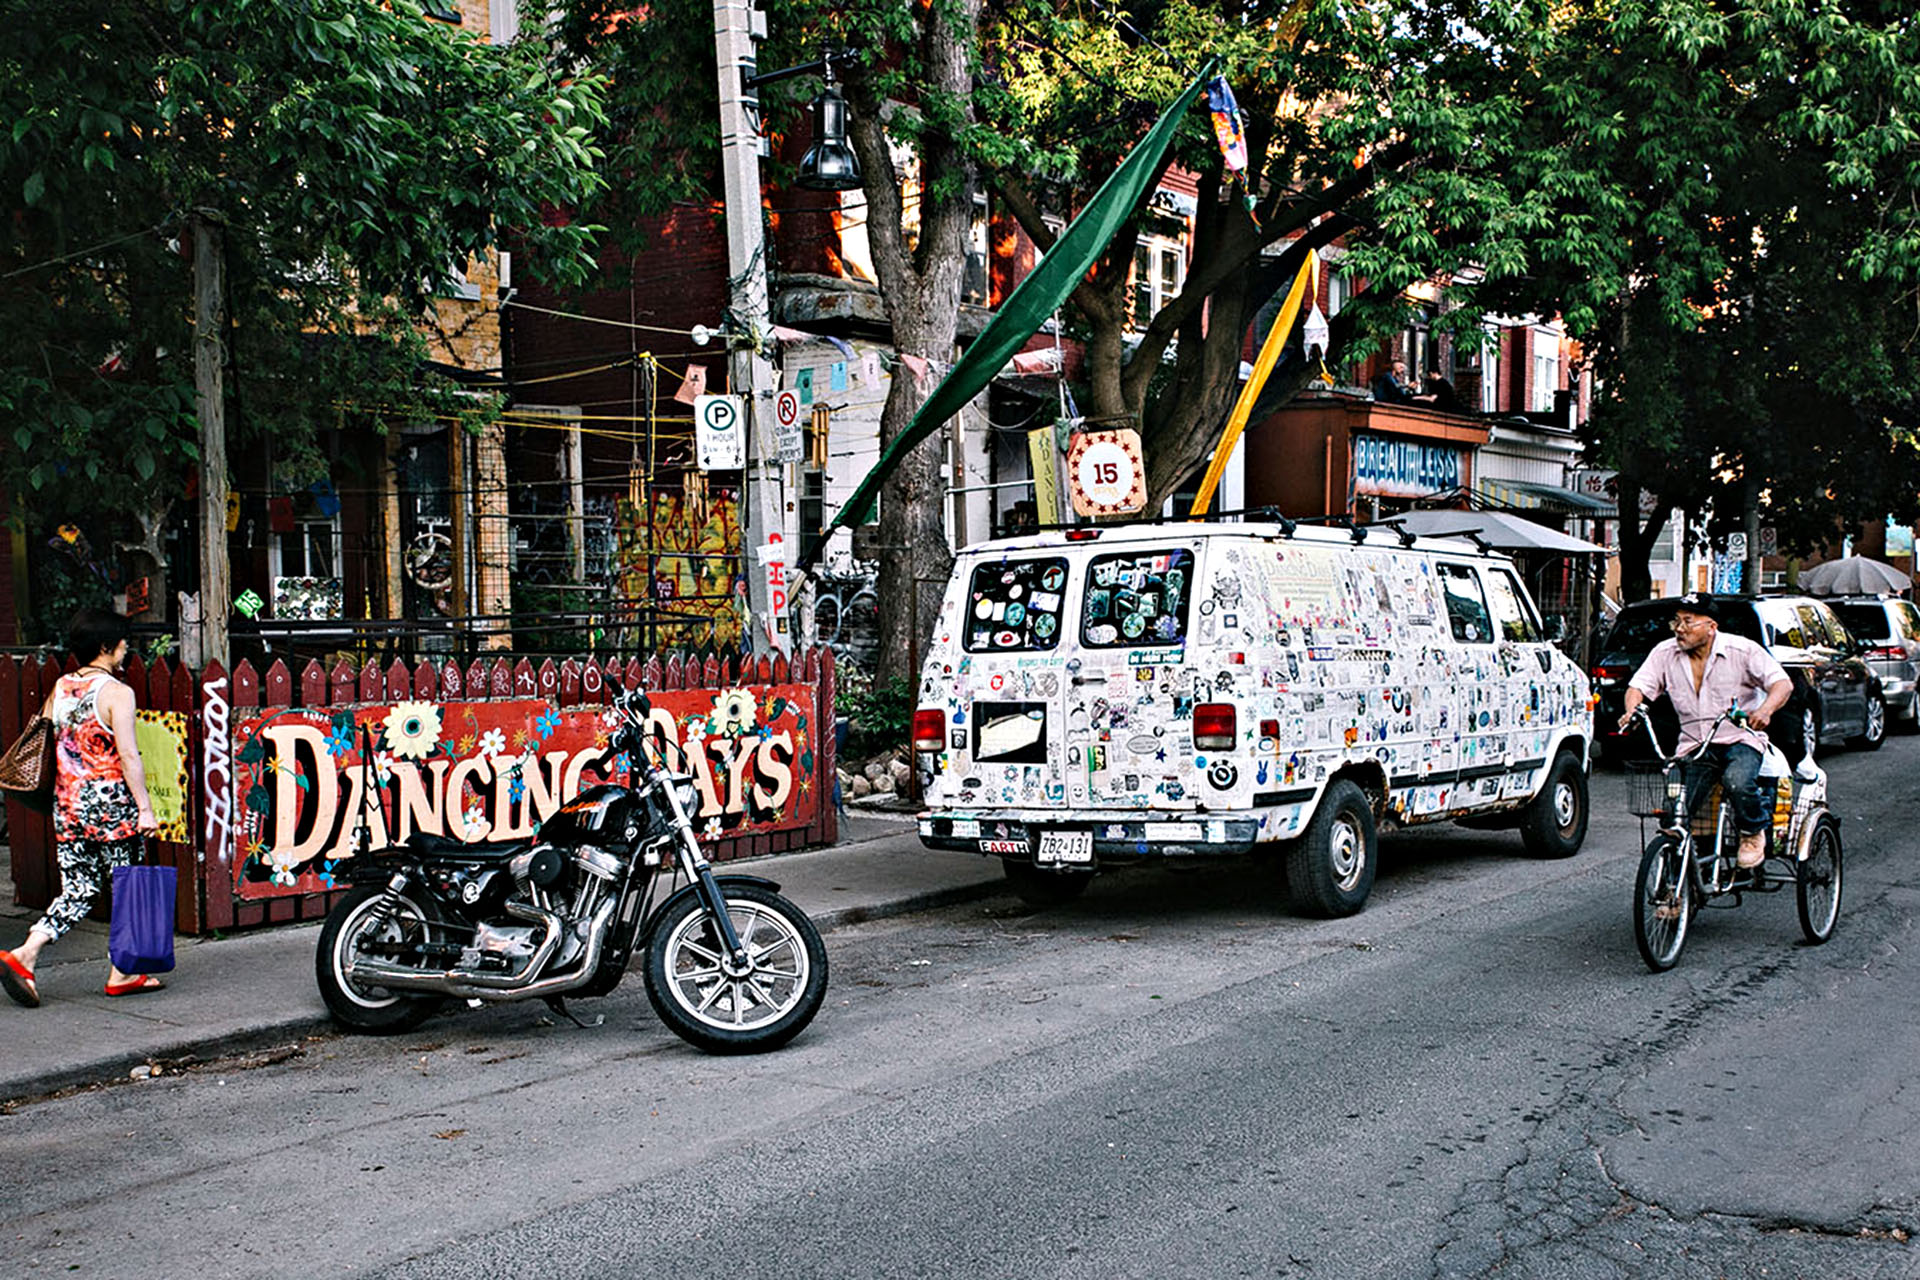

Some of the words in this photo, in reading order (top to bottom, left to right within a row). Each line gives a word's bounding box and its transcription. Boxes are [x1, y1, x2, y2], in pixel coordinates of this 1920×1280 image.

[714, 406, 729, 424] P
[712, 432, 736, 443] HOUR
[1357, 437, 1458, 485] BREATHLESS
[1093, 462, 1119, 485] 15
[240, 591, 260, 613] 15
[261, 724, 613, 866] DANCING
[642, 707, 794, 818] DAYS
[981, 841, 1030, 853] EARTH
